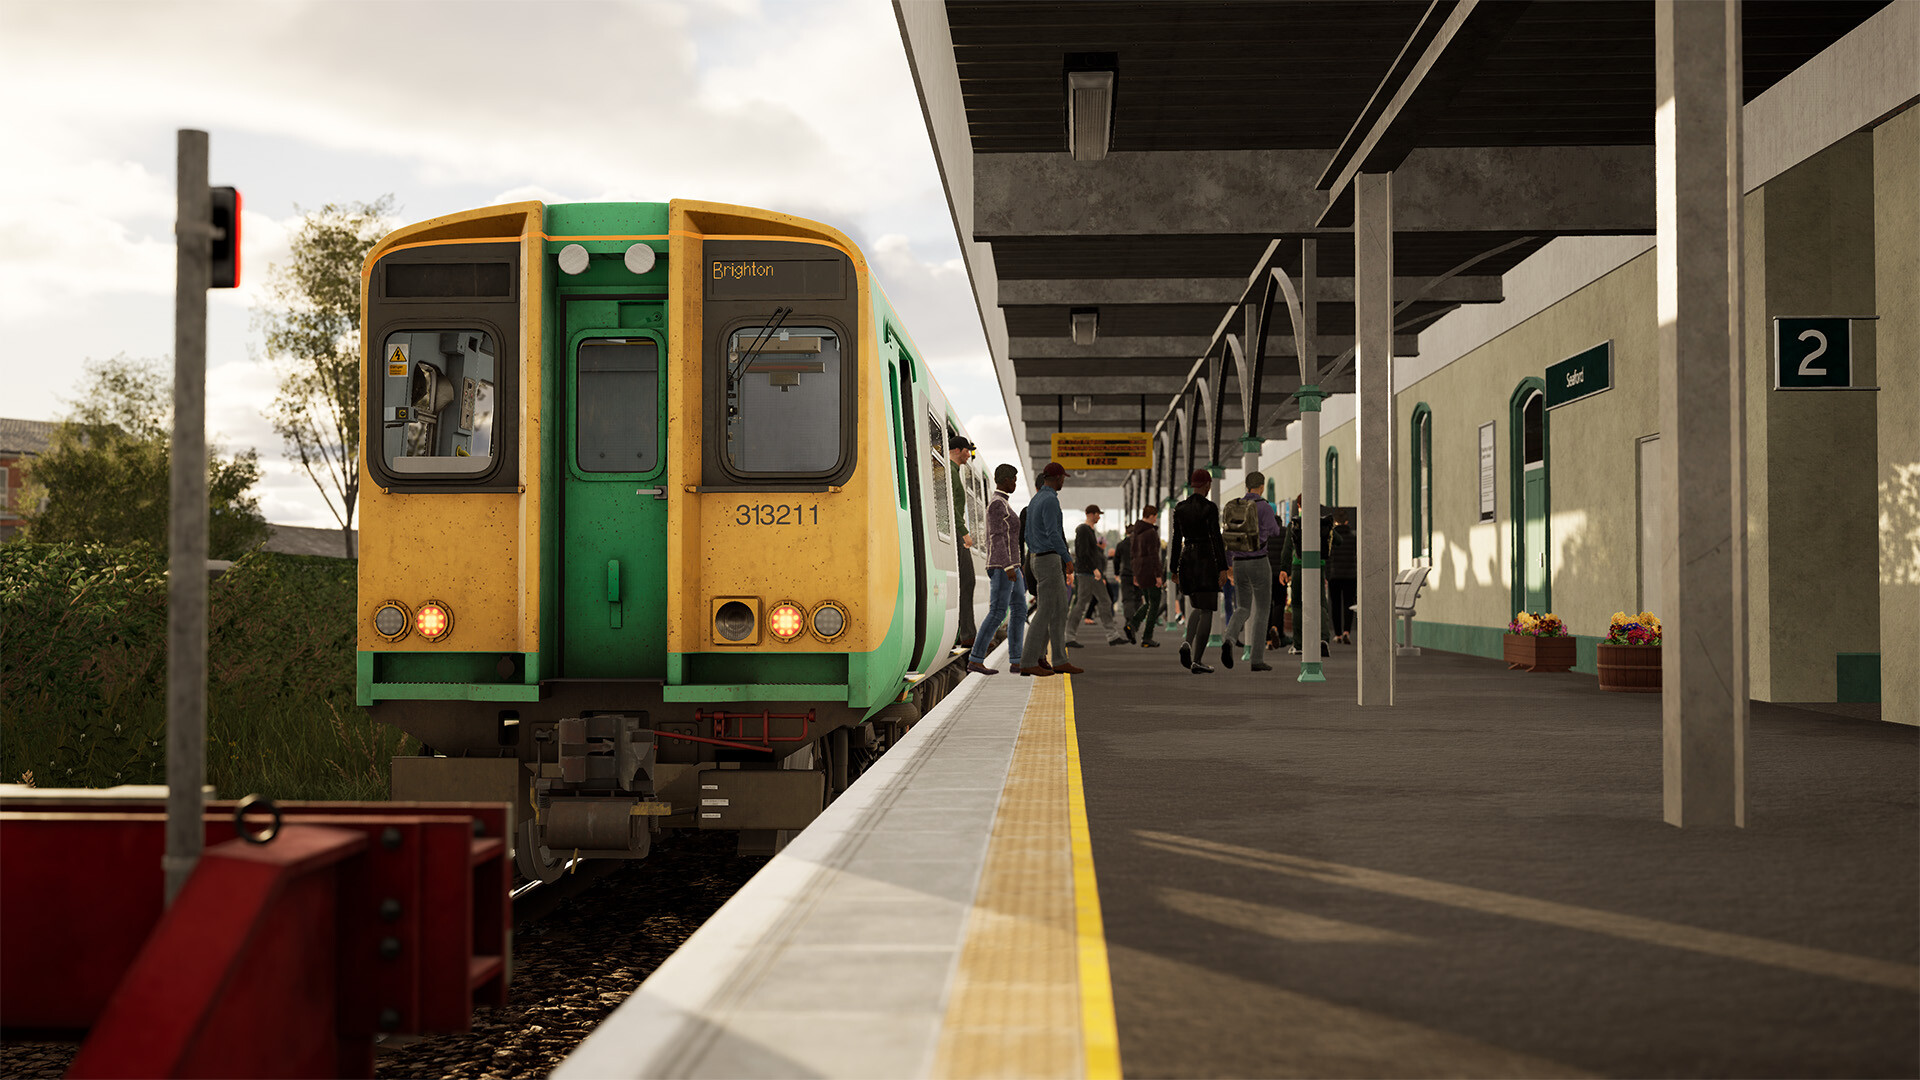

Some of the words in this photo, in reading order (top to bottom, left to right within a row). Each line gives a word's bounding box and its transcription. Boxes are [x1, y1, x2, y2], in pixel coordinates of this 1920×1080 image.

[713, 261, 774, 279] Brighton
[1798, 329, 1828, 376] 2
[1566, 366, 1584, 388] Seaford
[736, 504, 818, 525] 313211
